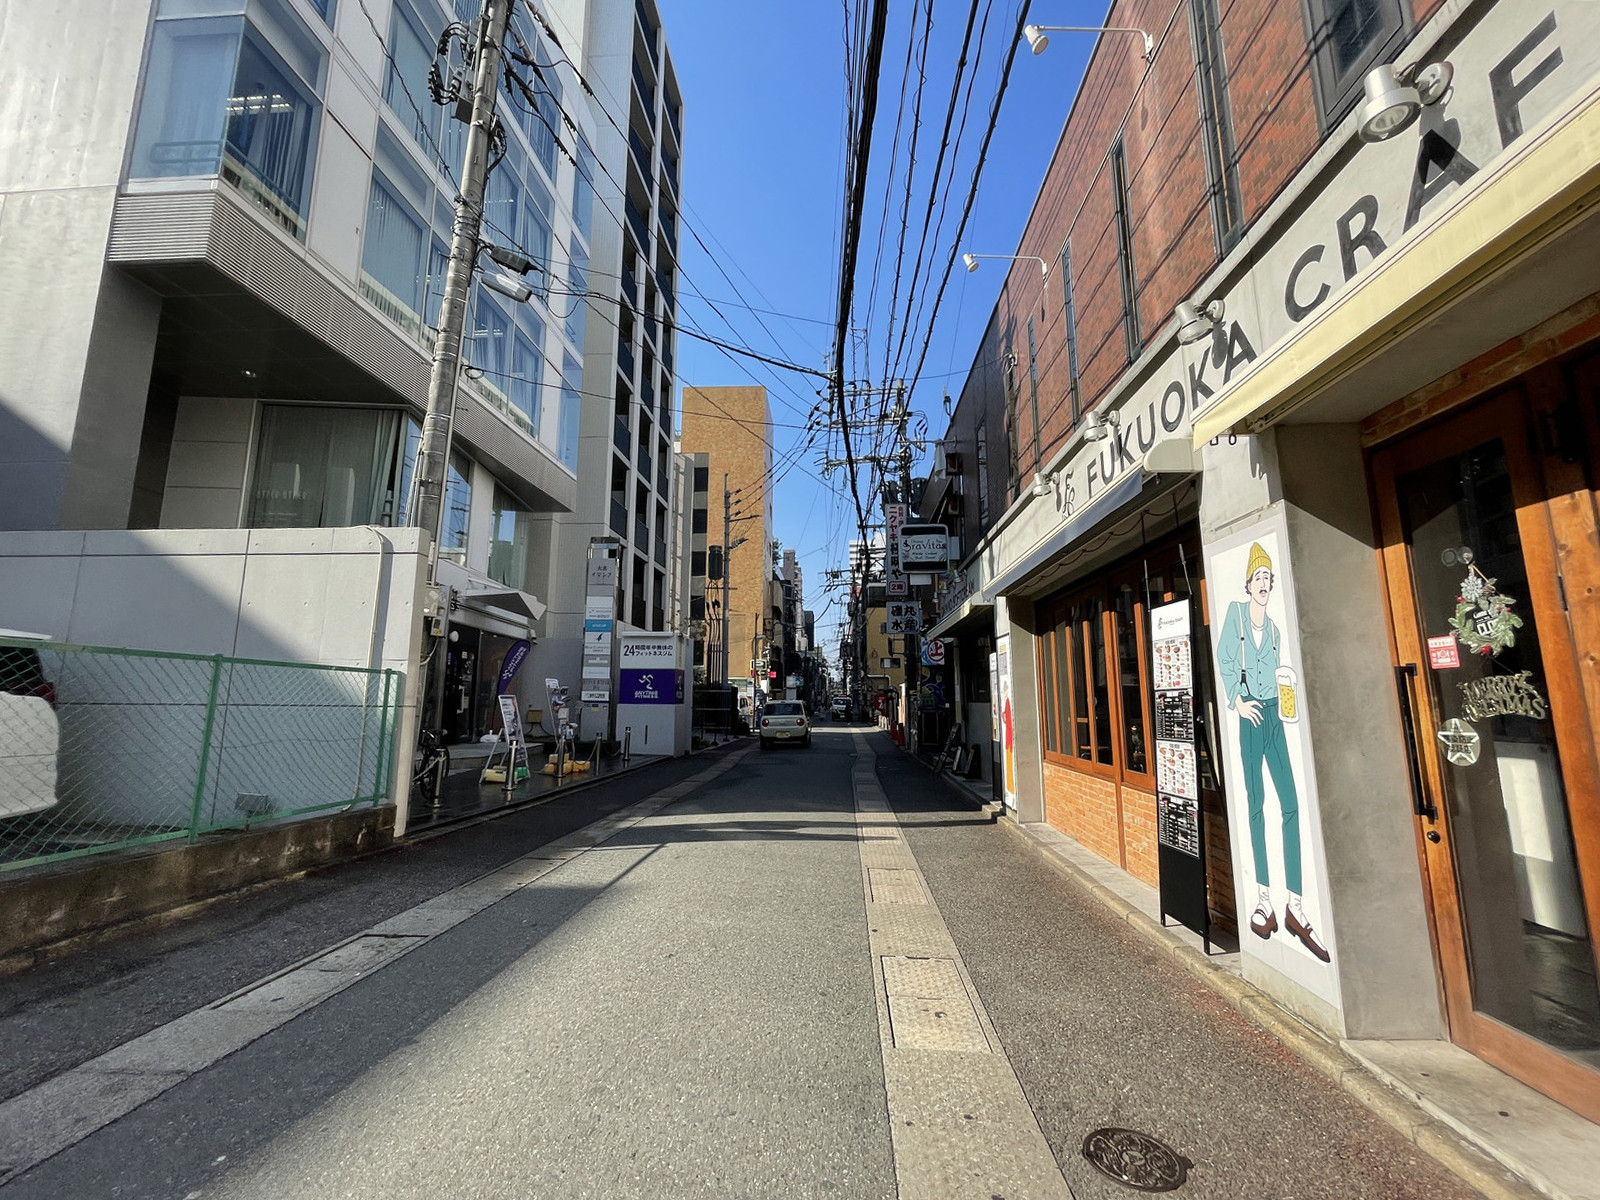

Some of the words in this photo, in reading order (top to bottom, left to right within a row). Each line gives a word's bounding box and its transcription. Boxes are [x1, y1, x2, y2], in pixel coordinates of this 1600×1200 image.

[1086, 320, 1257, 499] FUKUOKA
[623, 644, 635, 656] 24
[1463, 674, 1528, 703] MERRY
